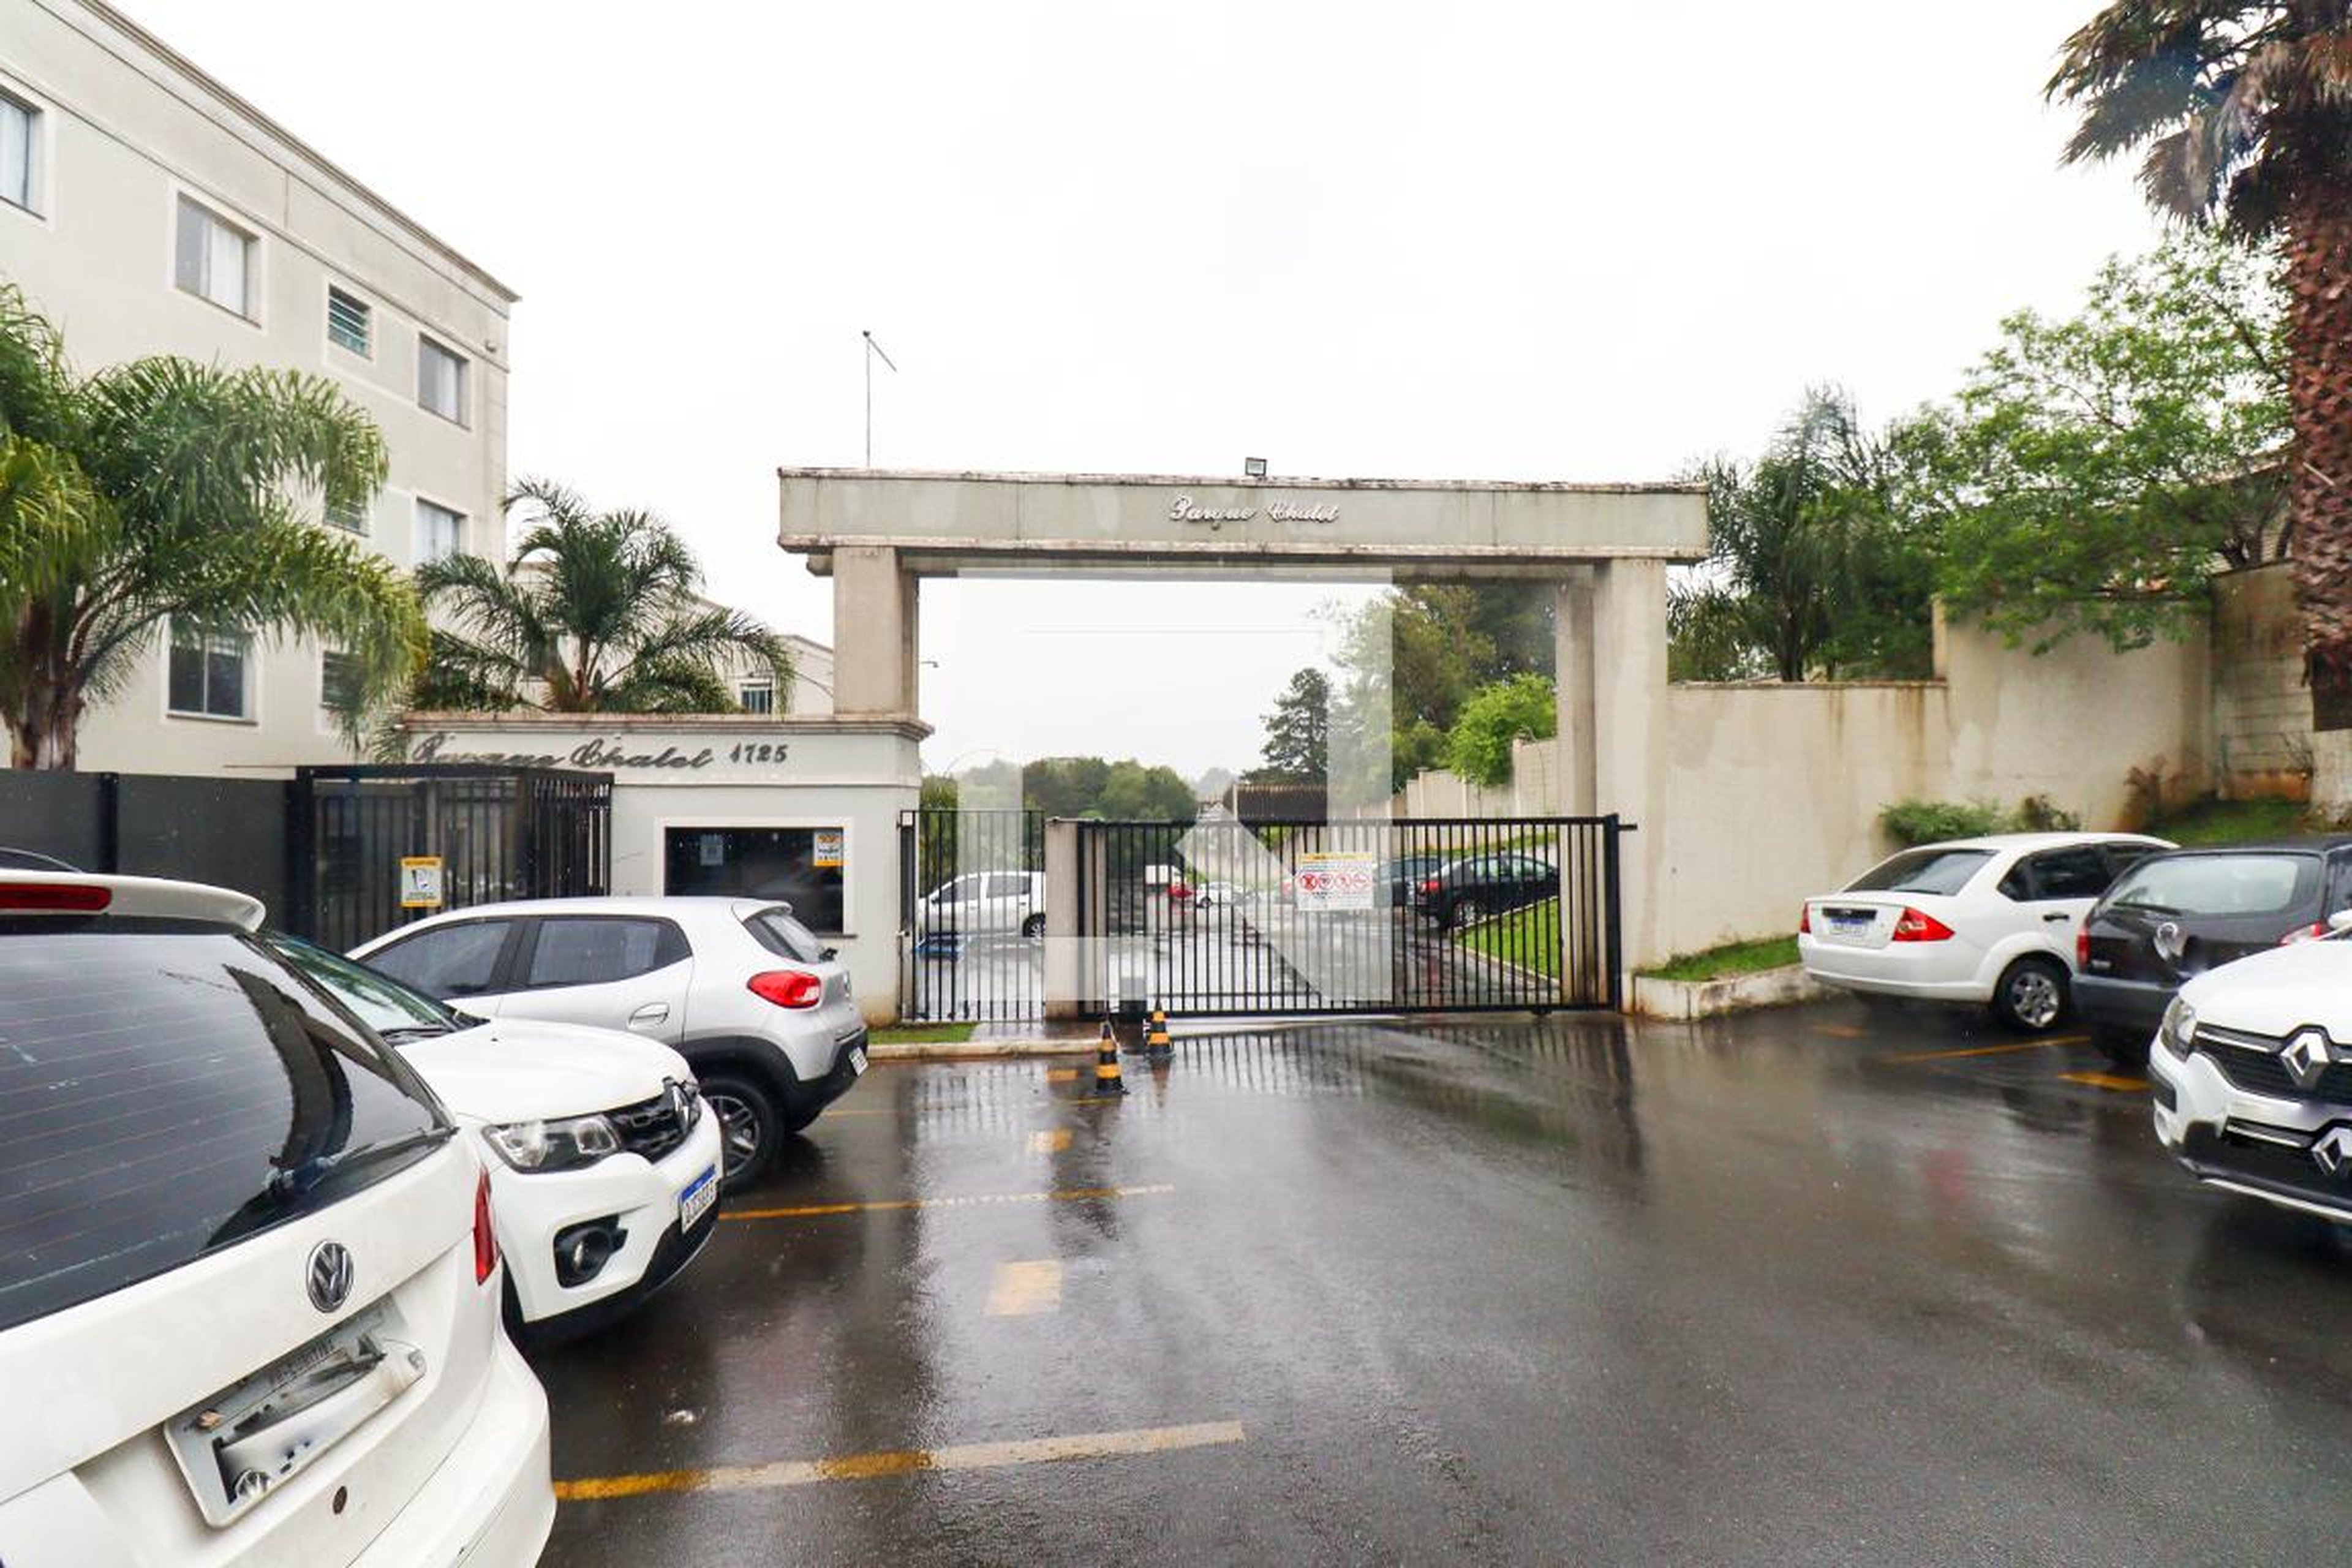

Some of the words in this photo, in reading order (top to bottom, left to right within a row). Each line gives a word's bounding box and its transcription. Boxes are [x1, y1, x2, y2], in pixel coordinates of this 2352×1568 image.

[1169, 494, 1256, 530] Parque
[570, 738, 714, 769] Chalet
[729, 742, 788, 764] 1725
